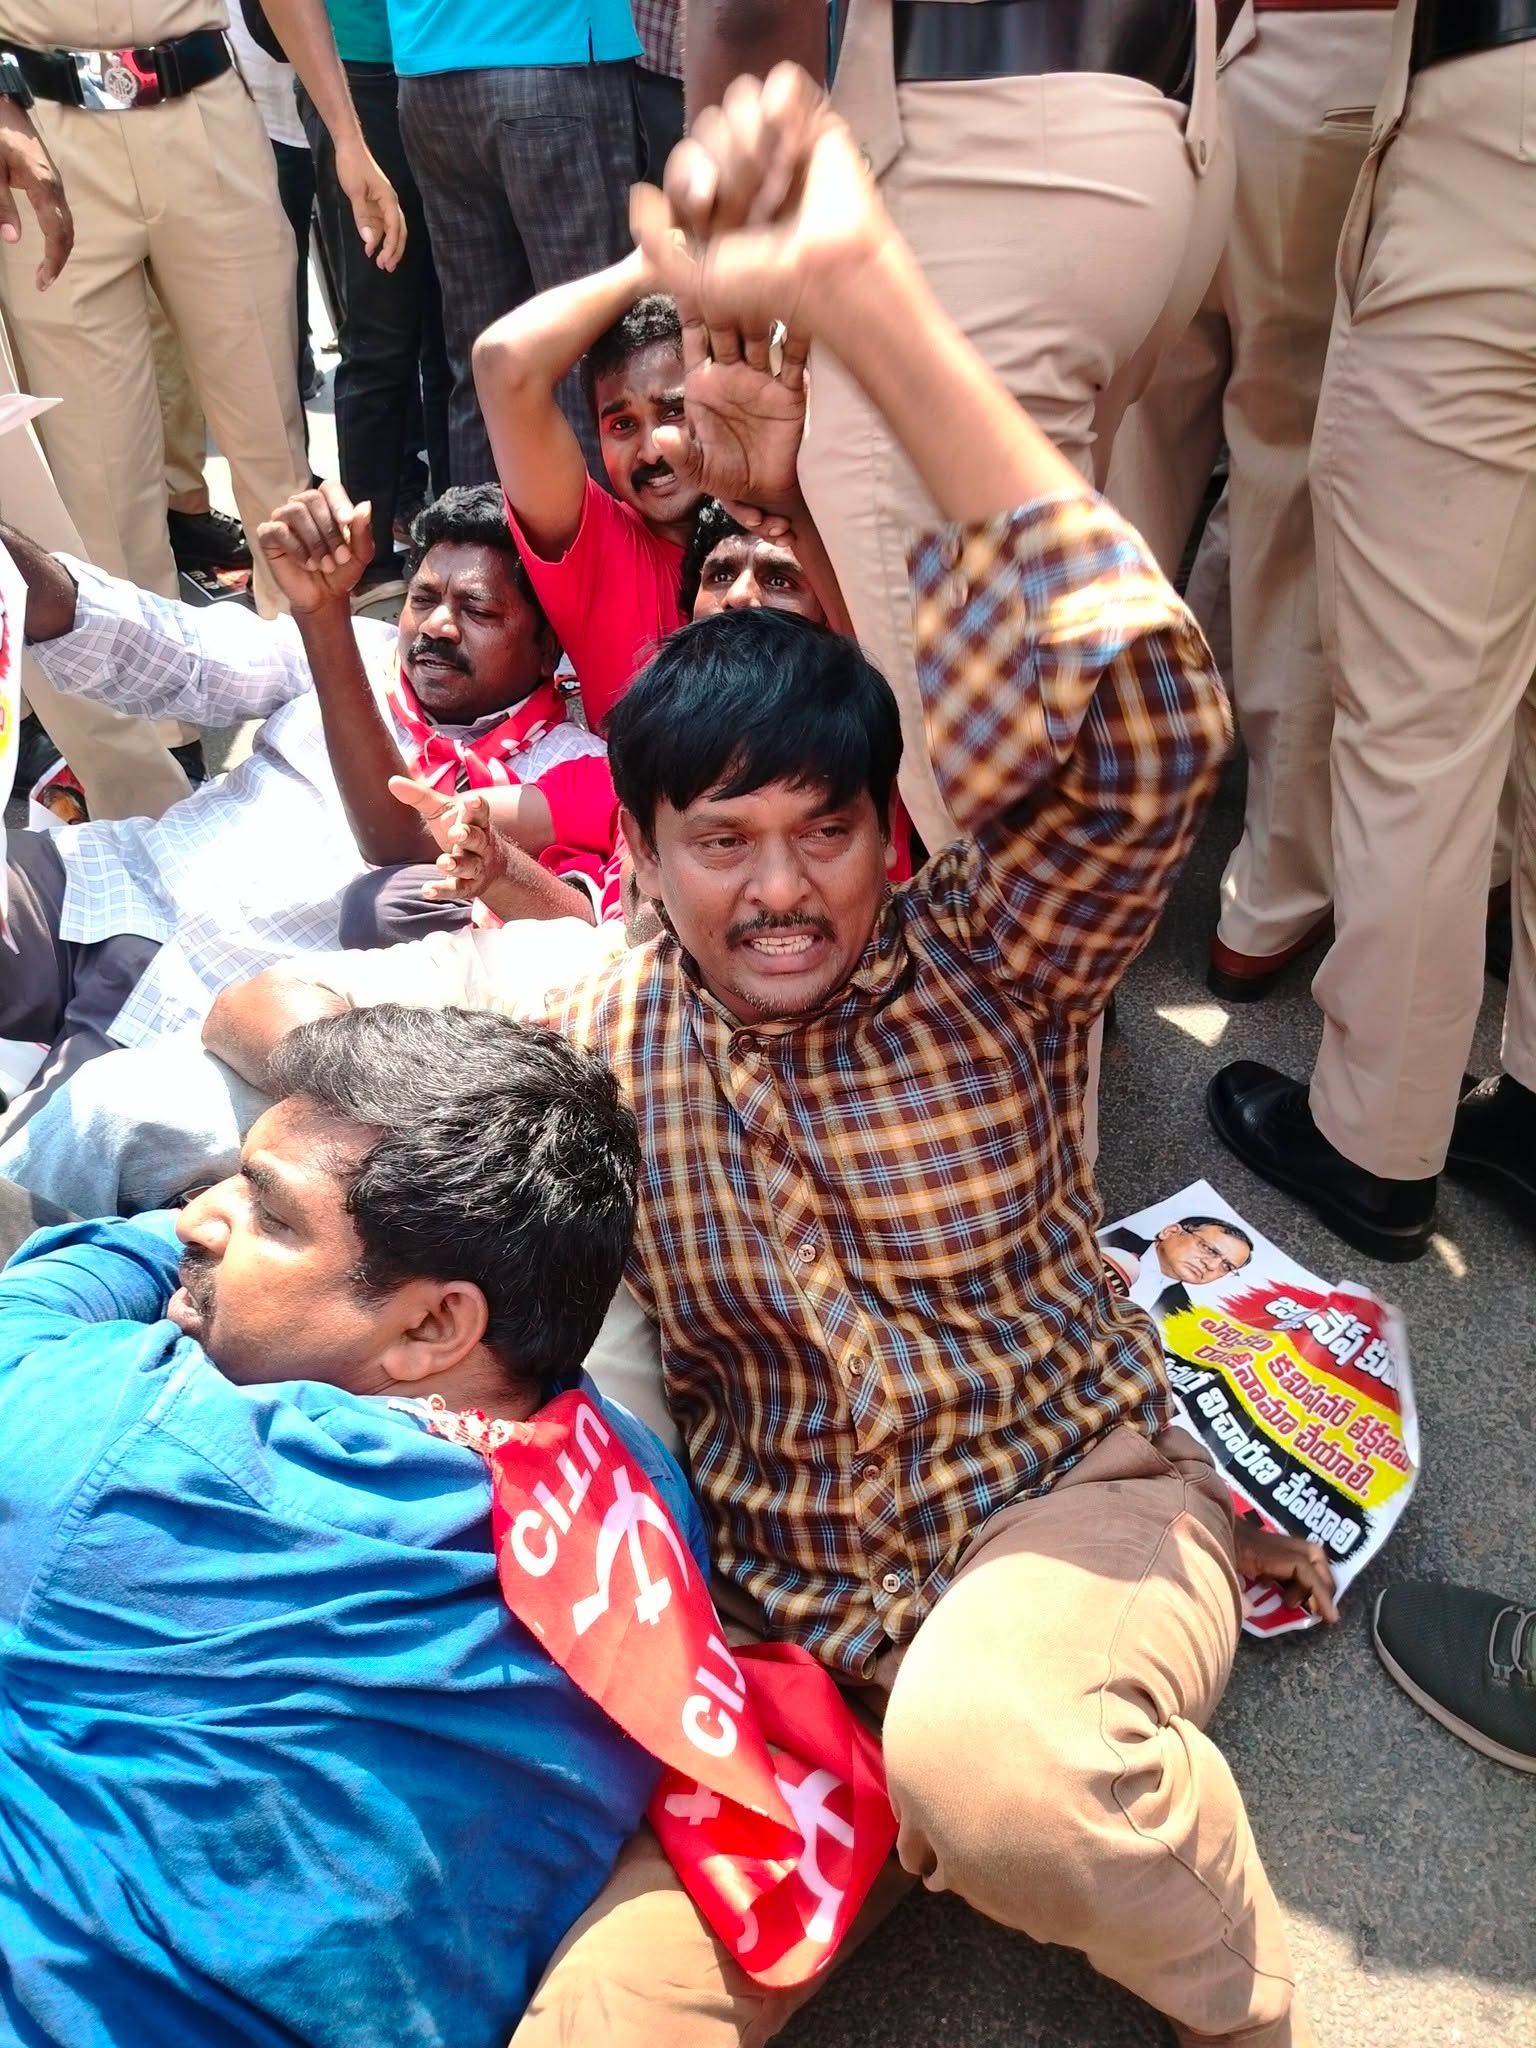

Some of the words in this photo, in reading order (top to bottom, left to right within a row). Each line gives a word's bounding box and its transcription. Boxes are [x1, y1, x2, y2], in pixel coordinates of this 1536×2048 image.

[1192, 1344, 1299, 1436] రాజీనామా
[1292, 1422, 1375, 1497] చేయాలి.
[1199, 1317, 1275, 1352] ఎన్నికల
[1267, 1353, 1357, 1427] కమిషనర్
[1196, 1387, 1284, 1486] విచారణ
[1272, 1470, 1361, 1554] చేపట్టాలి
